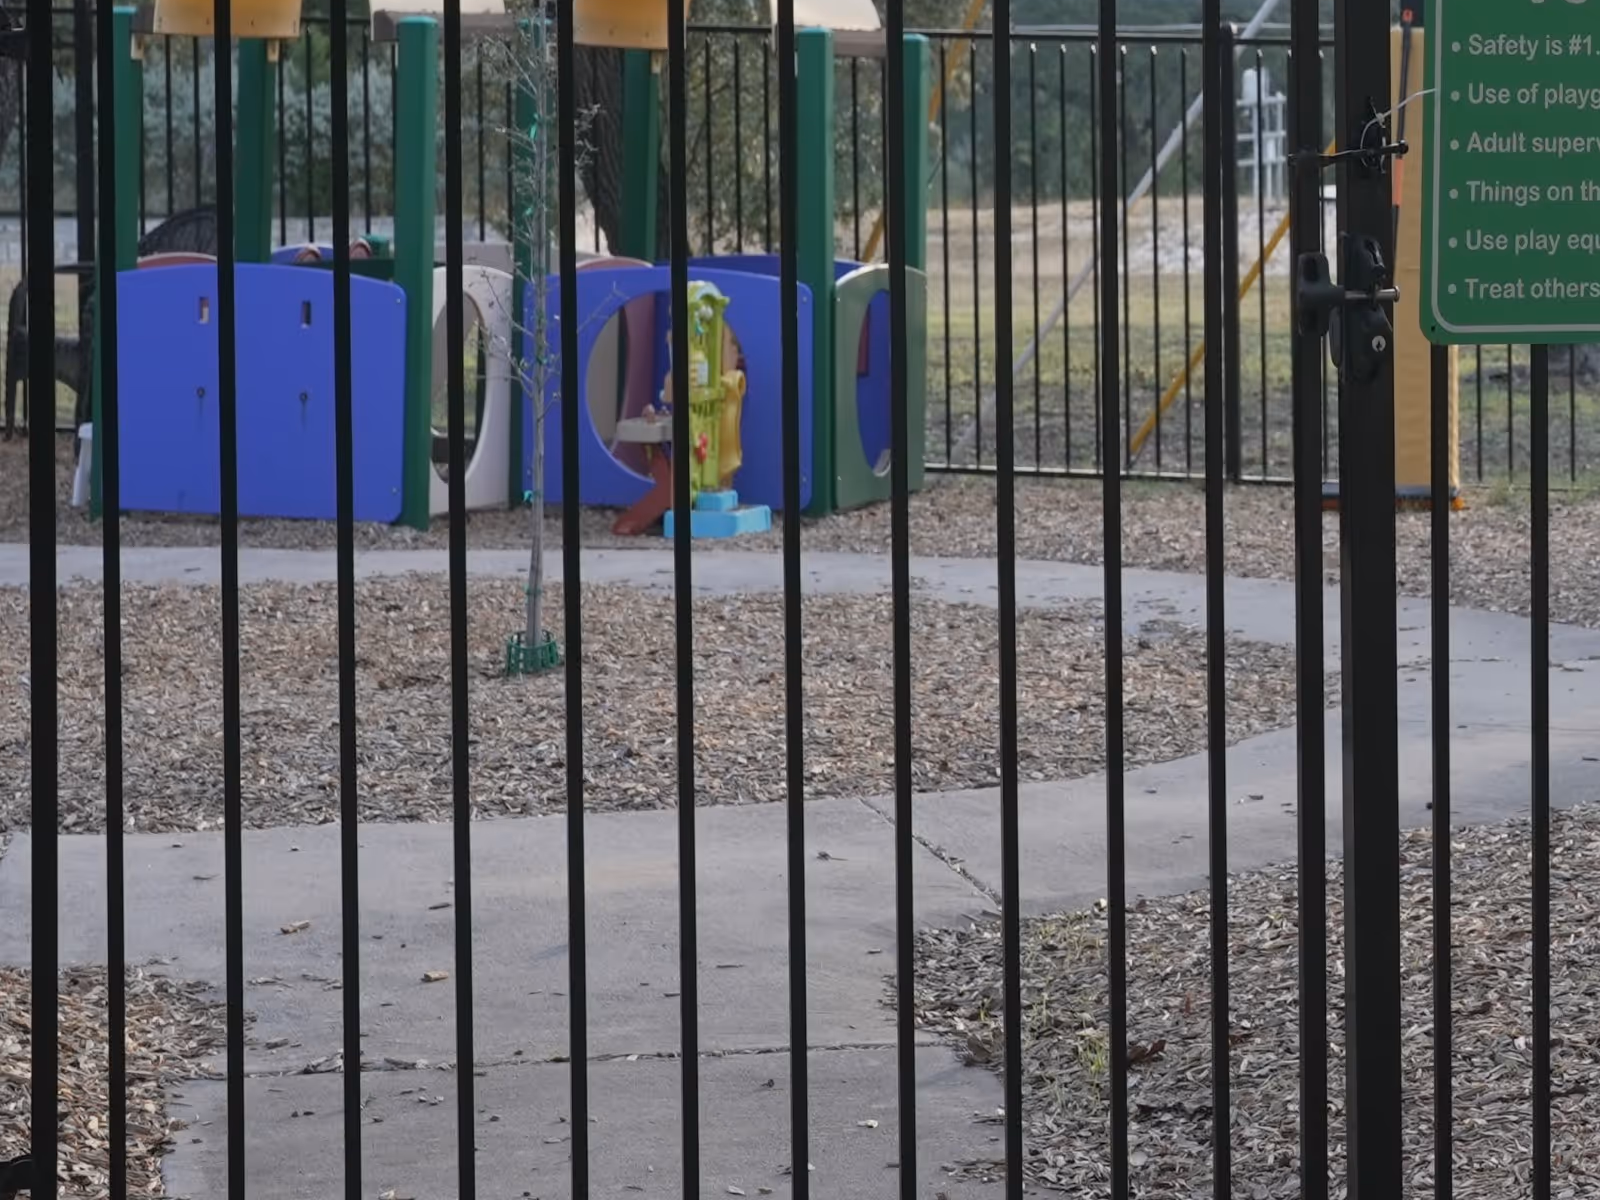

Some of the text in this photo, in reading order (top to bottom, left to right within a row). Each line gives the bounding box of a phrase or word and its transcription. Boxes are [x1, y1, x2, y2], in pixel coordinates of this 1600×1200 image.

[1468, 33, 1600, 61] Safety is #1.
[1468, 82, 1511, 105] Use
[1516, 82, 1540, 104] of
[1466, 131, 1527, 153] Adult
[1466, 180, 1541, 207] Things
[1546, 185, 1574, 201] on
[1466, 229, 1508, 251] Use
[1514, 229, 1561, 256] play
[1464, 278, 1525, 299] Treat
[1530, 277, 1600, 299] others
